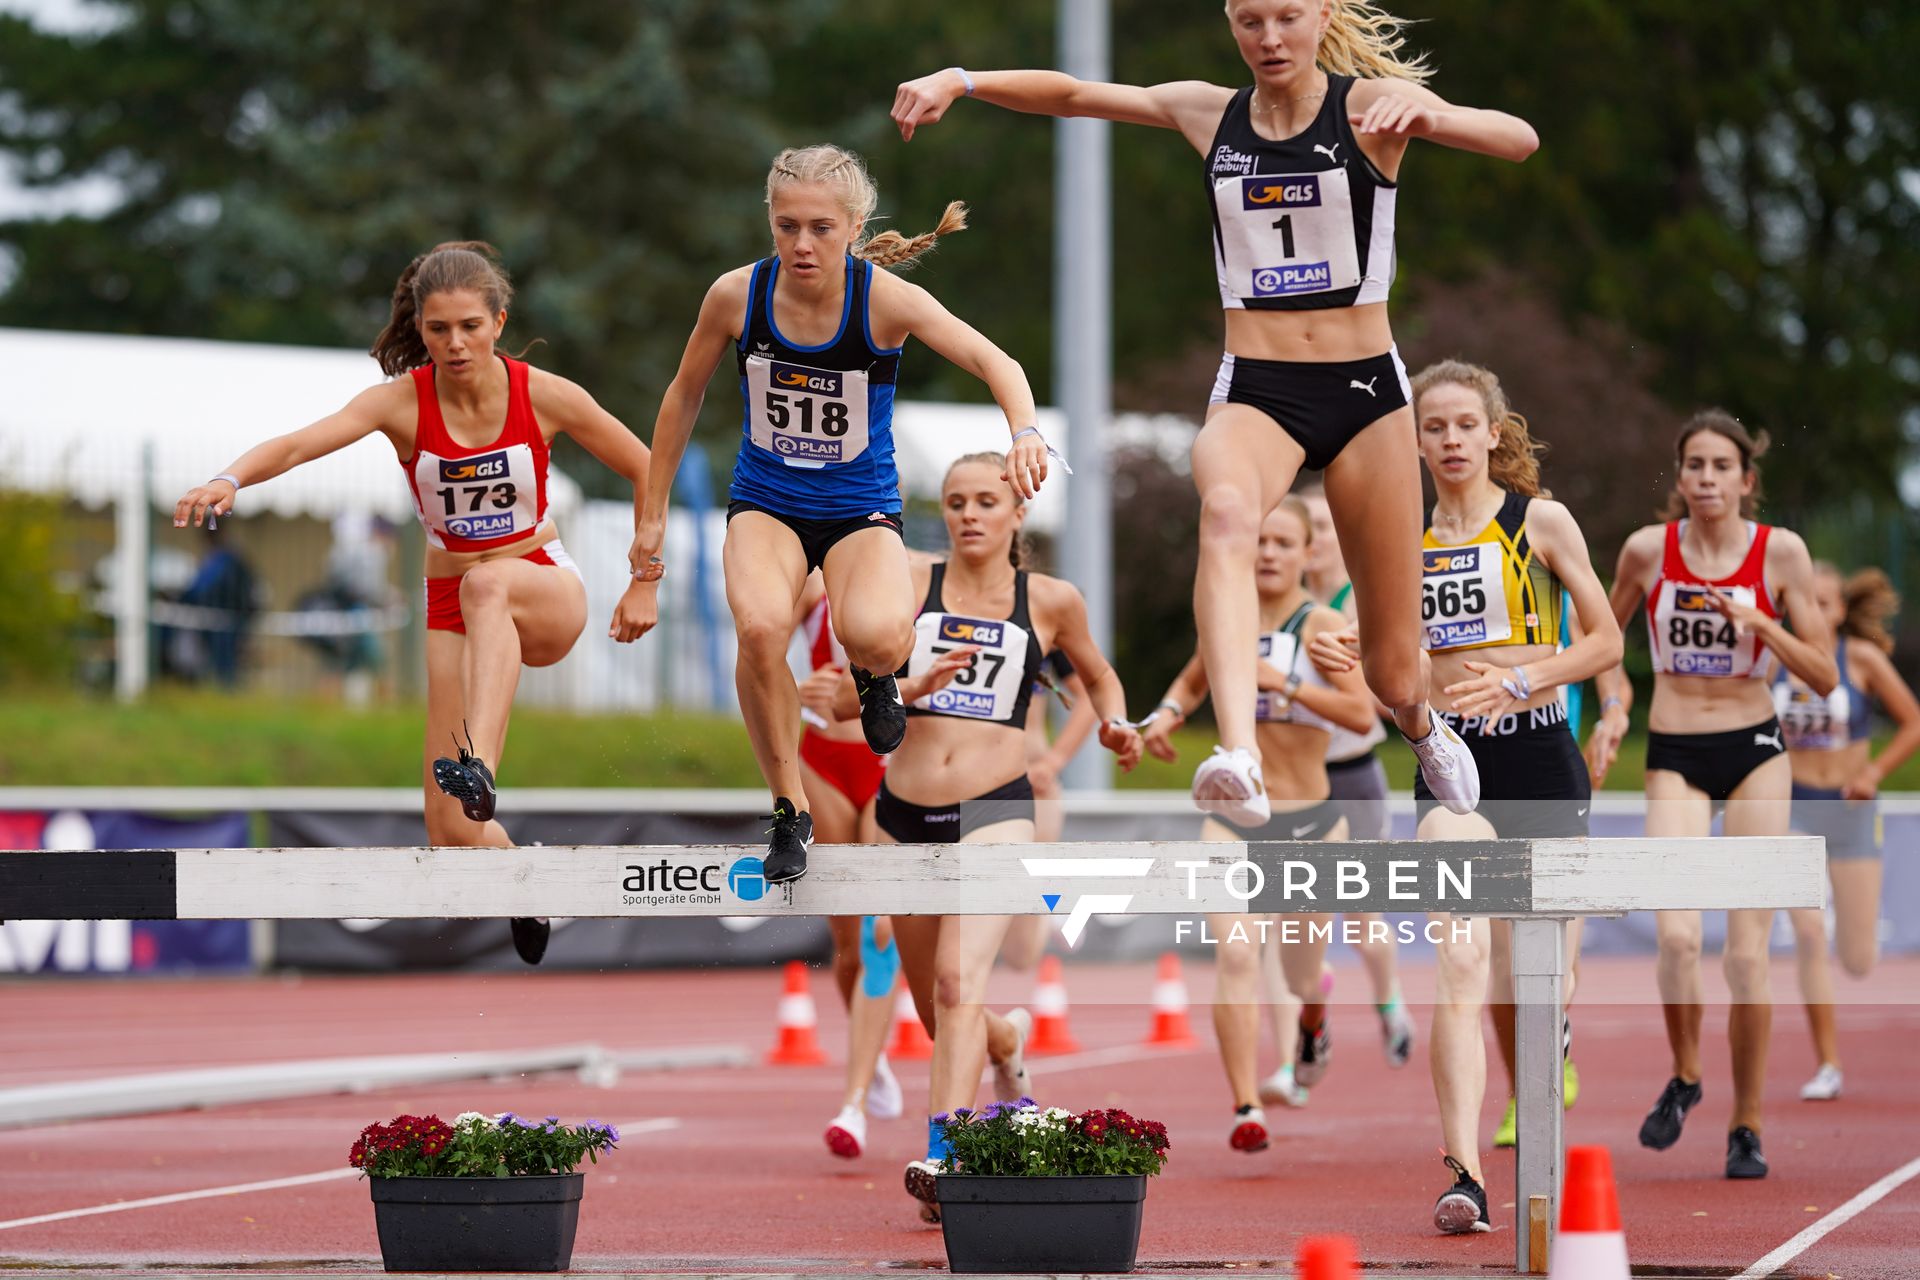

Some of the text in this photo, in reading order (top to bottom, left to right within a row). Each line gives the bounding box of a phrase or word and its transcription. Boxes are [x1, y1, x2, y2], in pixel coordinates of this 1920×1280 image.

[1283, 184, 1313, 202] GLS
[1272, 214, 1295, 259] 1
[1283, 267, 1328, 284] PLAN
[1284, 281, 1329, 291] INTERNATIONAL
[808, 376, 836, 392] GLS
[766, 391, 849, 437] 518
[799, 441, 839, 454] PLAN
[476, 460, 503, 477] GLS
[436, 482, 517, 516] 173
[472, 516, 512, 532] PLAN
[1450, 553, 1475, 571] GLS
[972, 626, 1000, 643] GLS
[1446, 623, 1484, 638] PLAN
[1669, 617, 1738, 649] 864
[931, 646, 1006, 689] 37
[956, 694, 994, 709] PLAN
[622, 859, 720, 892] artec
[623, 894, 721, 906] Sportgeräte GmbH
